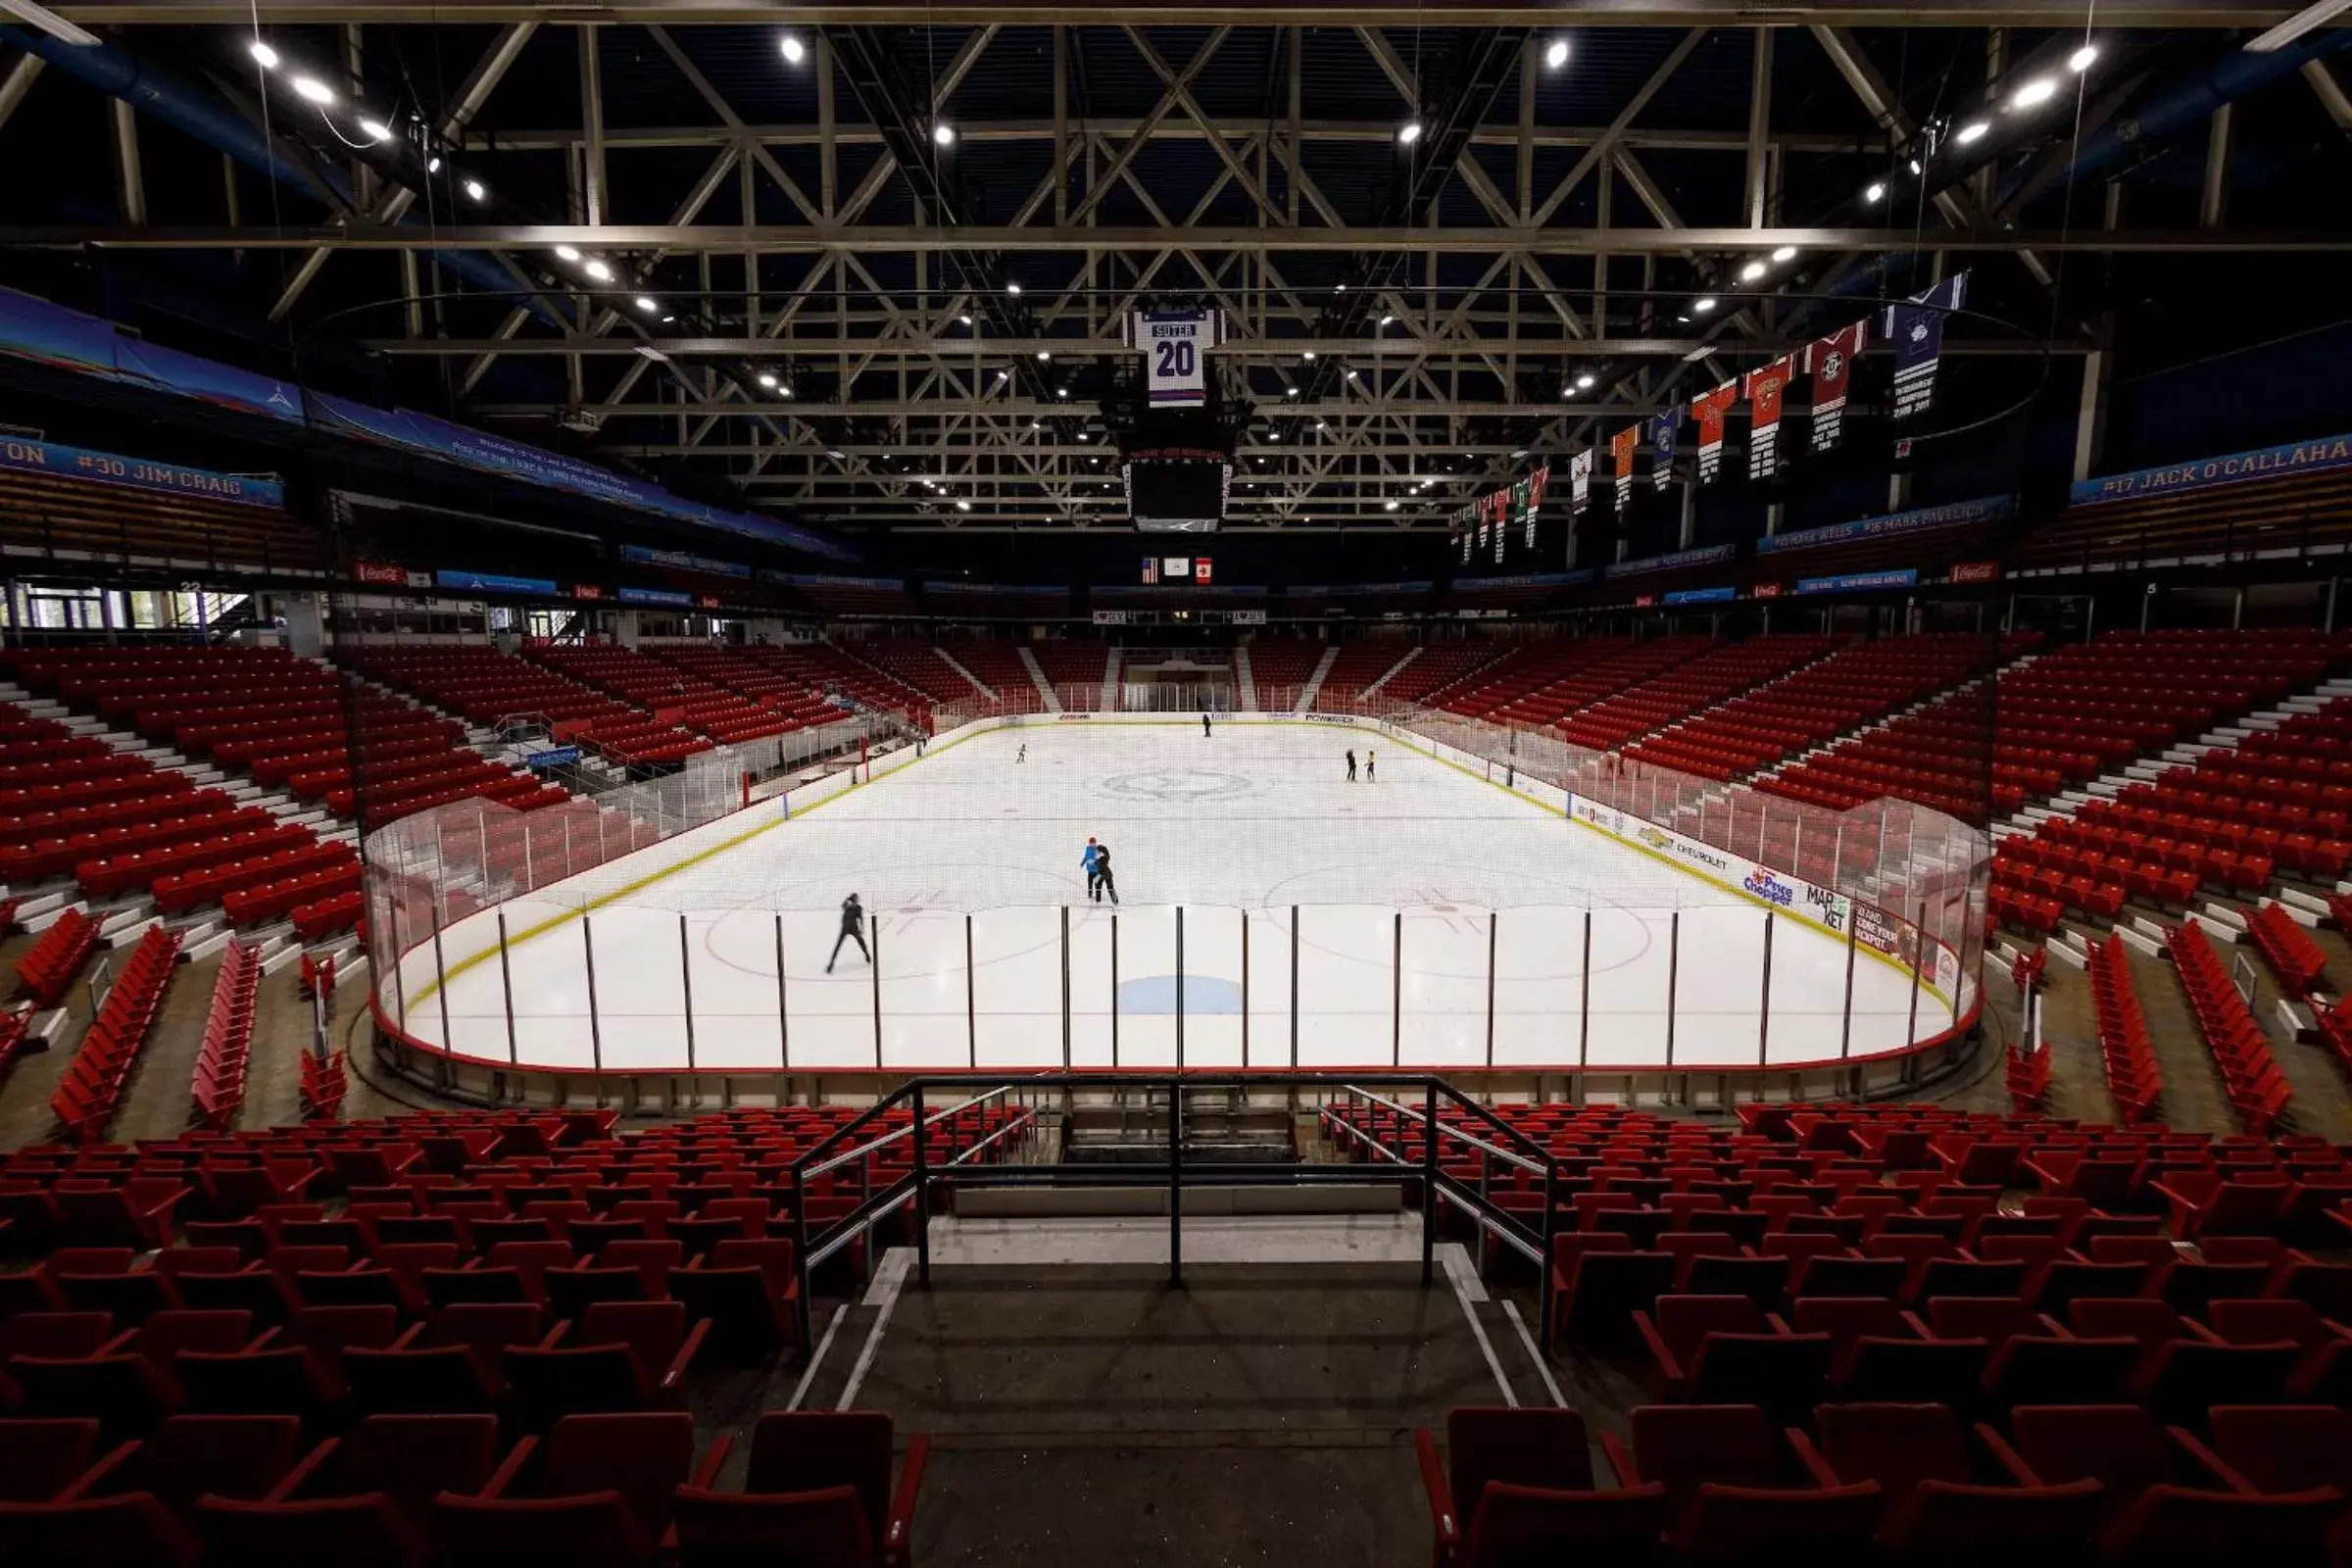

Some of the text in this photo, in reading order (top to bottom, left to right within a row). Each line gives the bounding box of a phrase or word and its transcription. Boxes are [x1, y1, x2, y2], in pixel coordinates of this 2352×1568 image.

[1153, 325, 1193, 336] SUTER
[1156, 341, 1194, 376] 20
[0, 441, 240, 495] ON #30 JIM CRAIG
[2104, 477, 2133, 492] #17
[2140, 466, 2195, 490] JACK
[1884, 516, 1918, 532] MARK
[1922, 505, 1984, 525] PAVELICH
[180, 580, 202, 592] 22
[1677, 844, 1727, 870] CHEVROLET
[1744, 878, 1793, 906] Chopper
[1765, 876, 1793, 898] Price
[1807, 885, 1834, 907] MAR
[1856, 916, 1898, 944] CORE YOUR
[1856, 928, 1885, 948] ACKPOT
